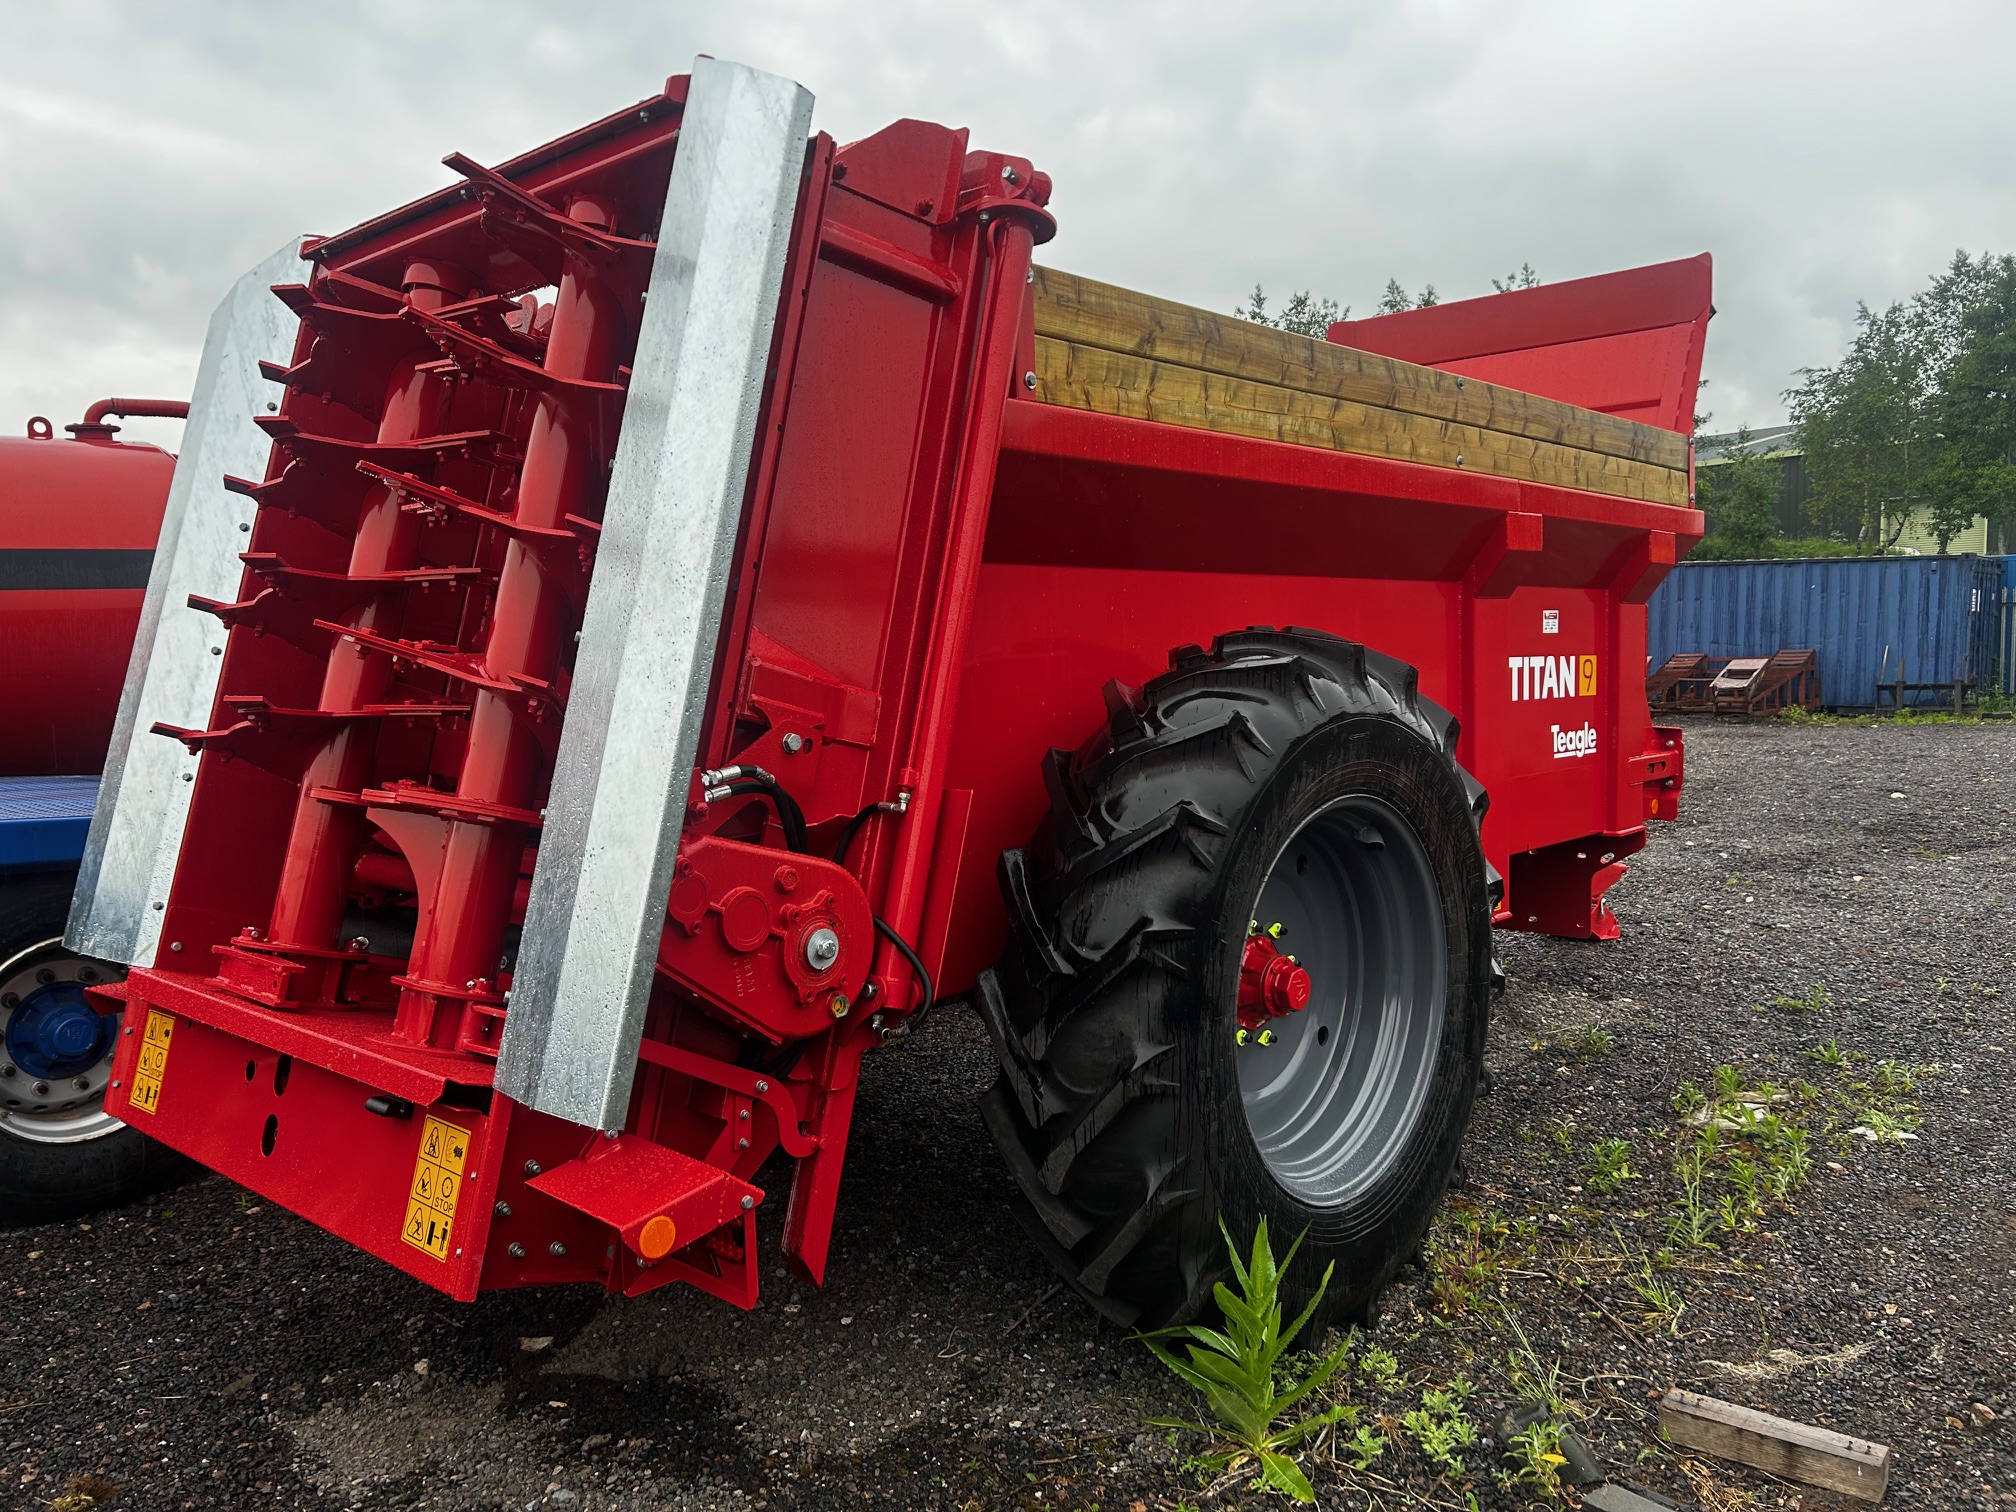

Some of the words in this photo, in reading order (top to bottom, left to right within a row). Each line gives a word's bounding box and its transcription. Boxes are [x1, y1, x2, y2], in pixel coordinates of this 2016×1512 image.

[1508, 655, 1576, 701] TITAN
[1582, 658, 1593, 692] 9
[1551, 721, 1597, 758] Teagle
[150, 1068, 162, 1078] STOP
[434, 1196, 454, 1213] STOP
